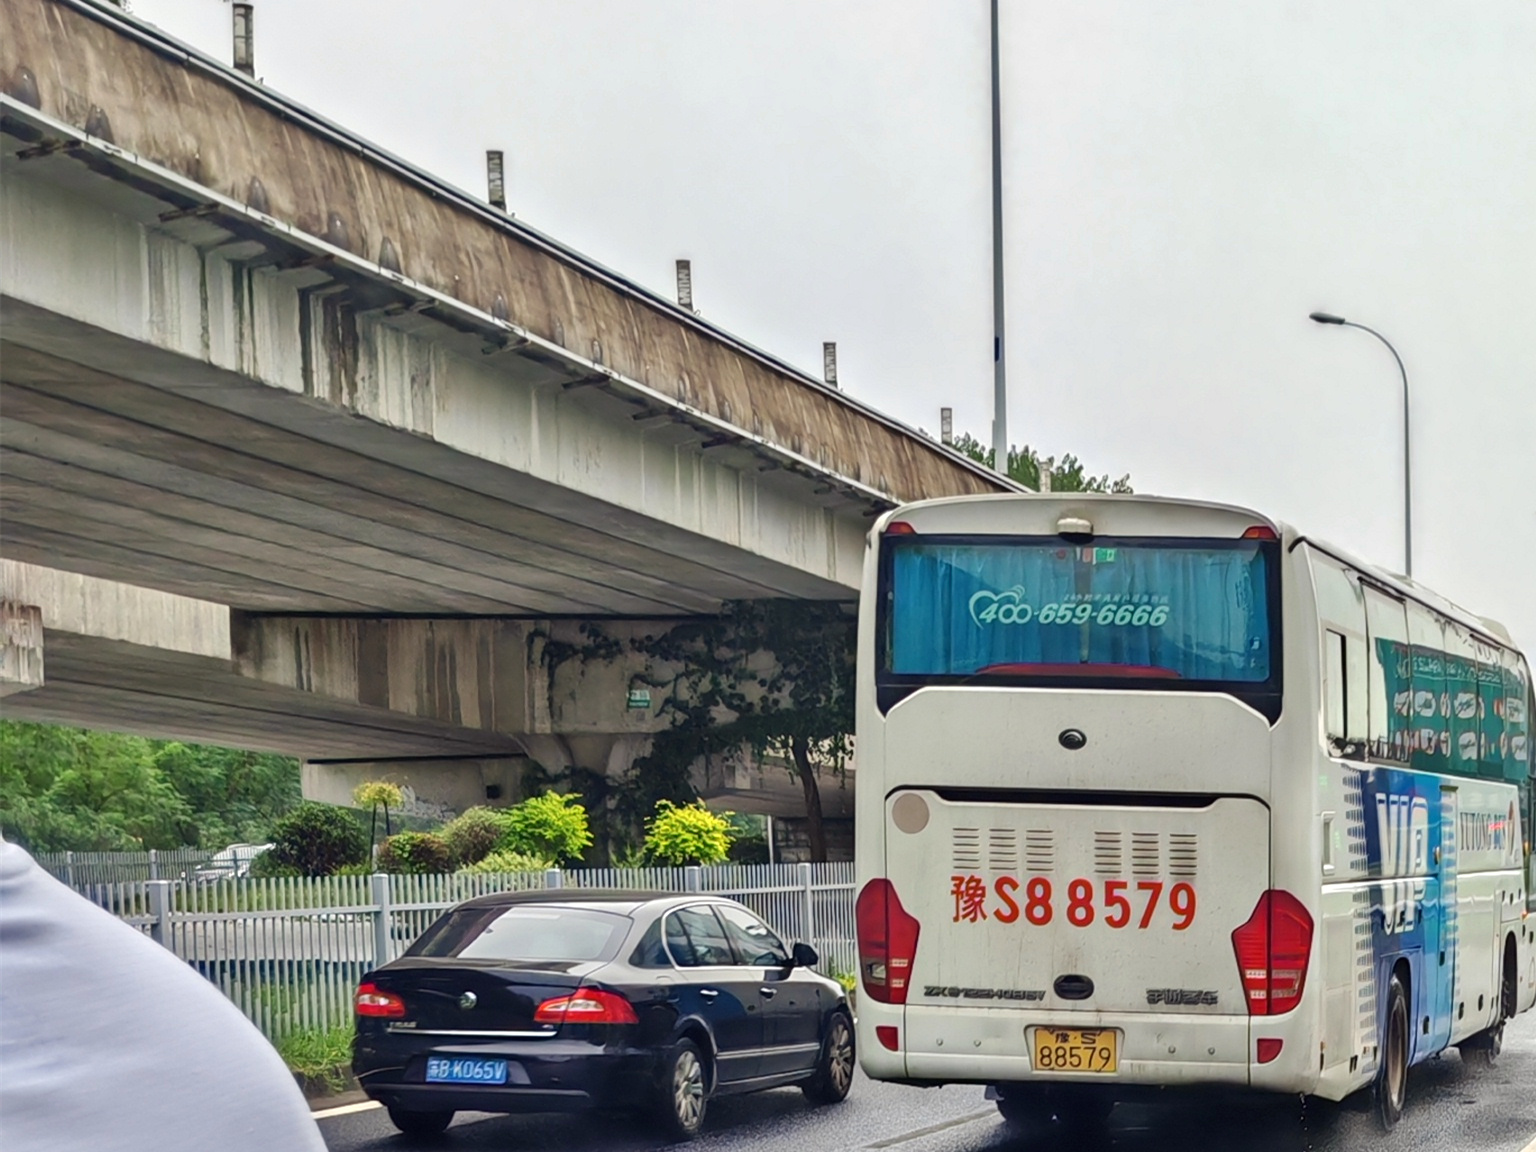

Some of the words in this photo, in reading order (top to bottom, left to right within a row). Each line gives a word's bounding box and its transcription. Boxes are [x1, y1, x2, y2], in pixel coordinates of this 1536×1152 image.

[979, 602, 1170, 627] 400-659-6666
[950, 874, 1197, 931] 豫S88579
[1039, 1045, 1111, 1069] 88579
